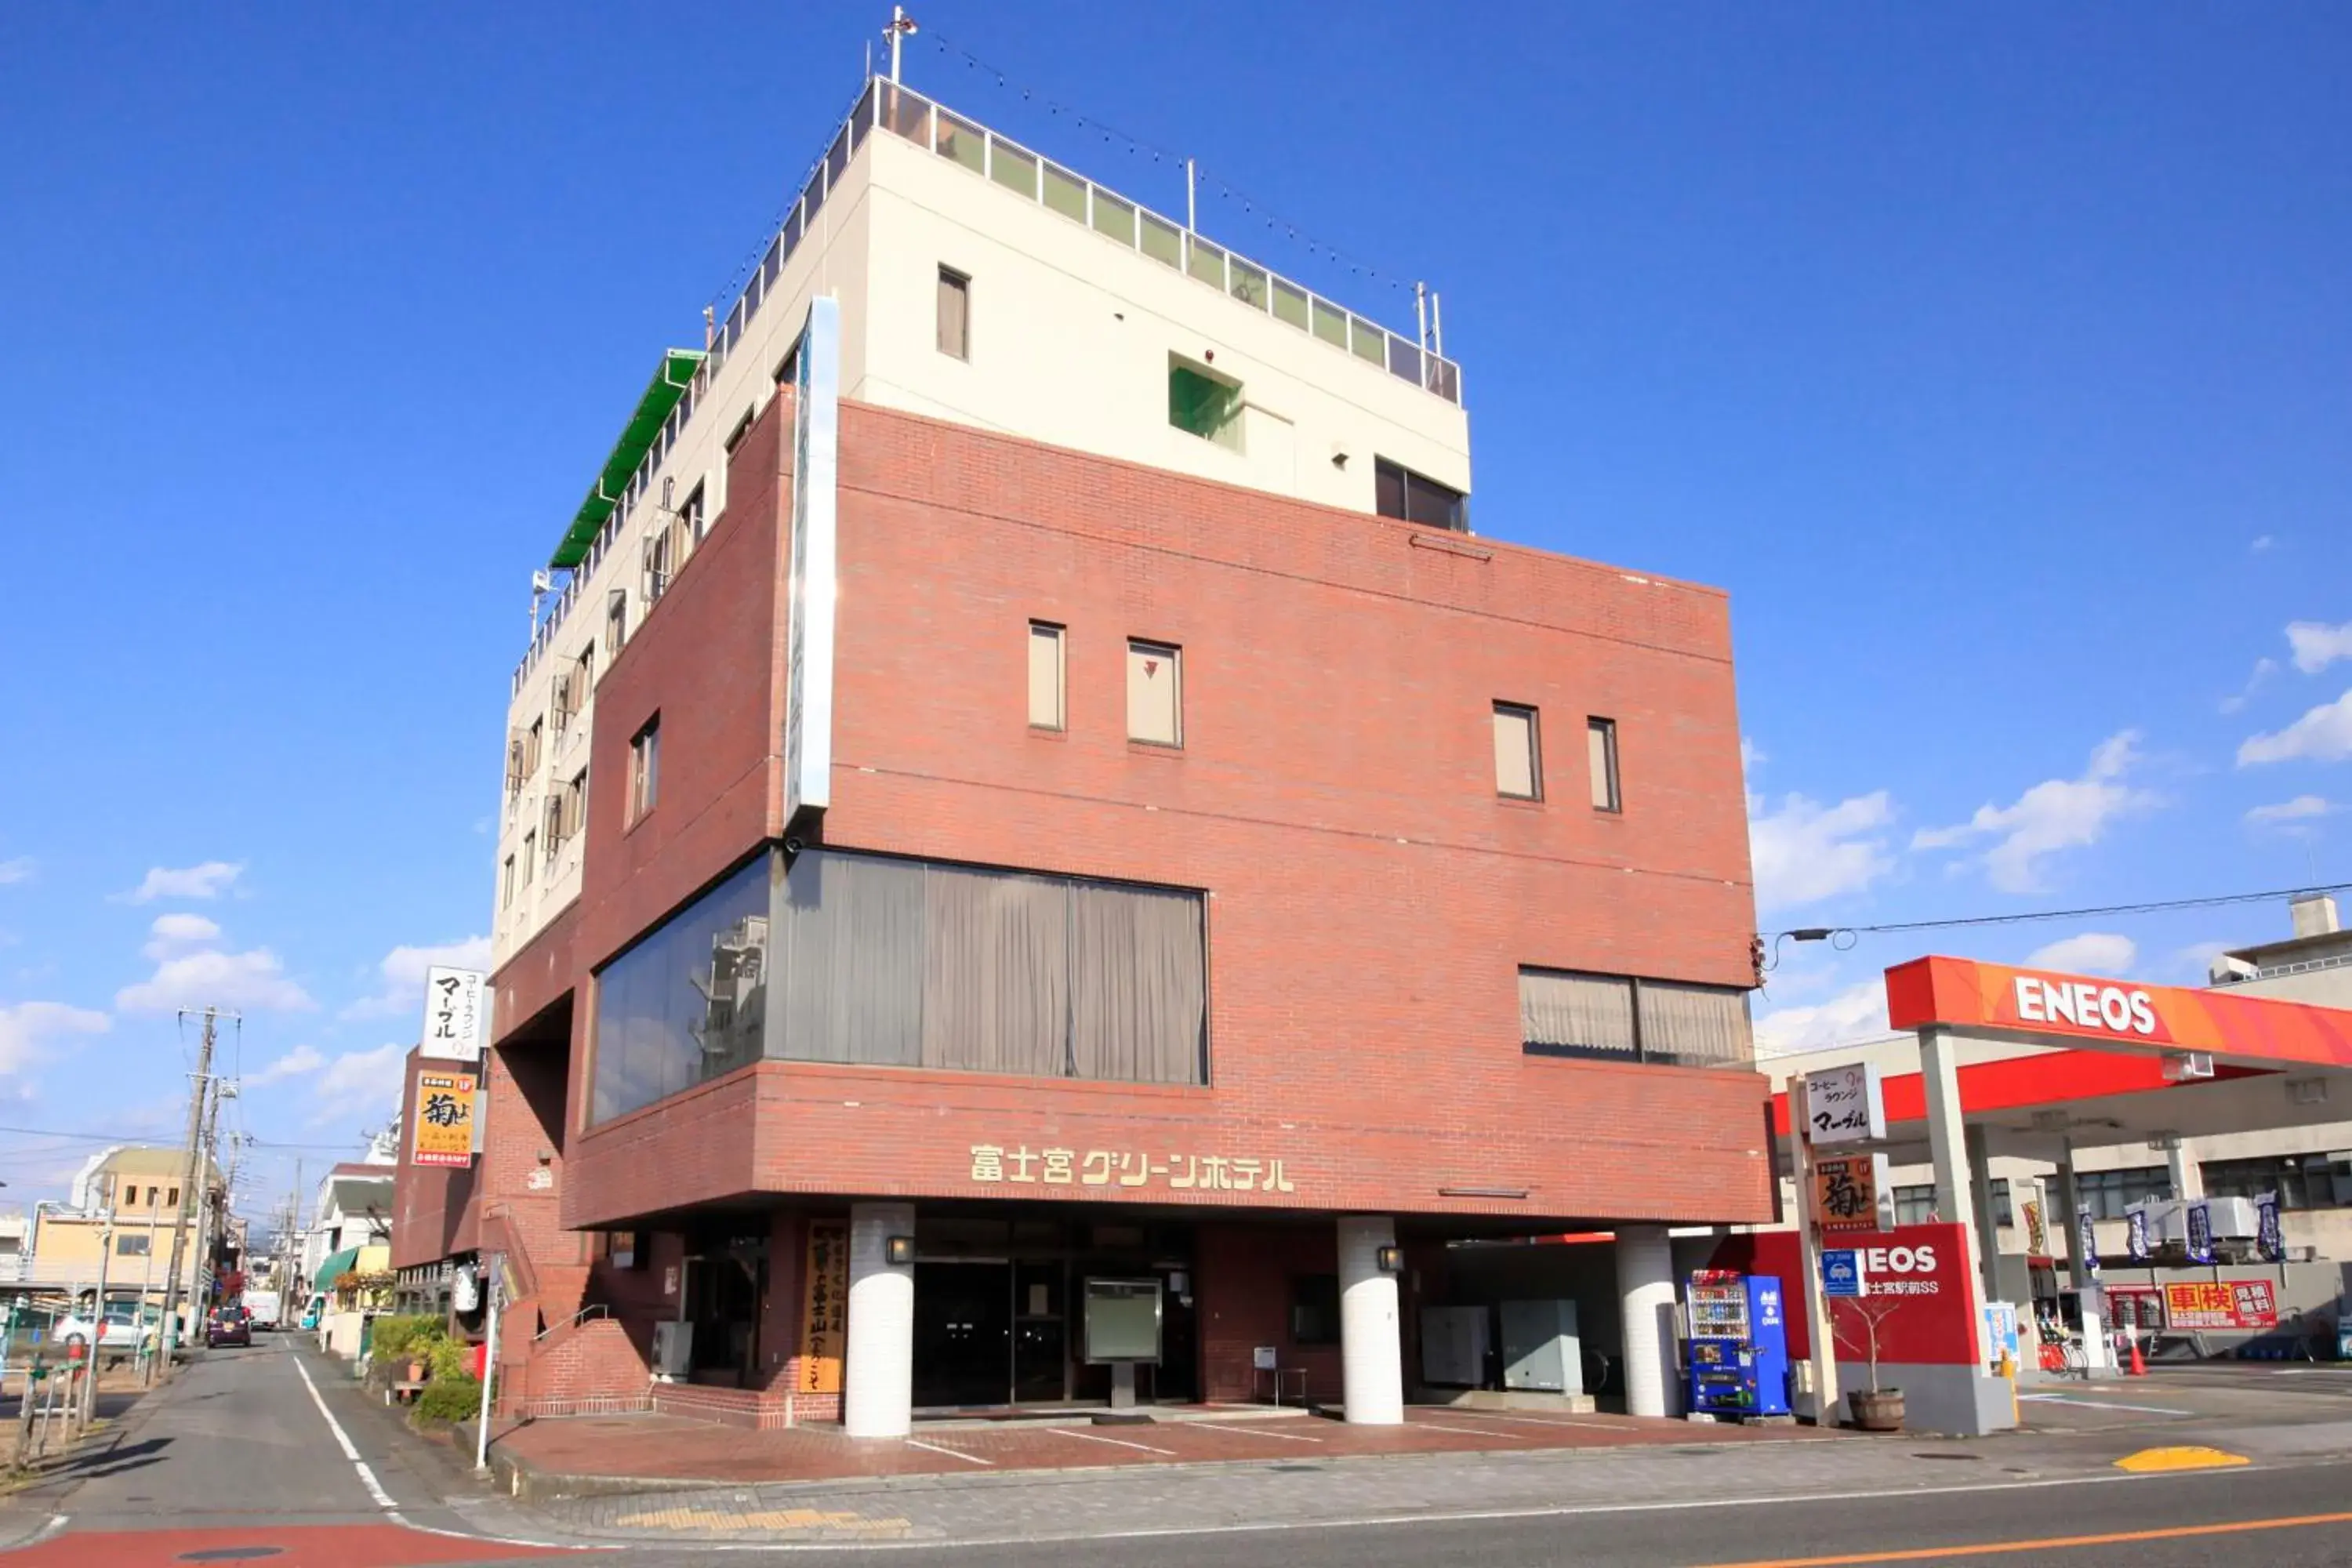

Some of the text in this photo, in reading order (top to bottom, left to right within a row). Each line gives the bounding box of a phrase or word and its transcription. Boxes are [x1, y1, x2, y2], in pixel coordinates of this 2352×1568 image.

[434, 976, 461, 1039] マーブル
[2015, 977, 2156, 1035] ENEOS
[1810, 1080, 1838, 1092] コーヒー
[1824, 1088, 1857, 1103] ラウンジ
[1813, 1109, 1867, 1132] マーブル
[970, 1145, 1294, 1192] 富士宮グリーンホテル
[2169, 1286, 2231, 1309] 車検
